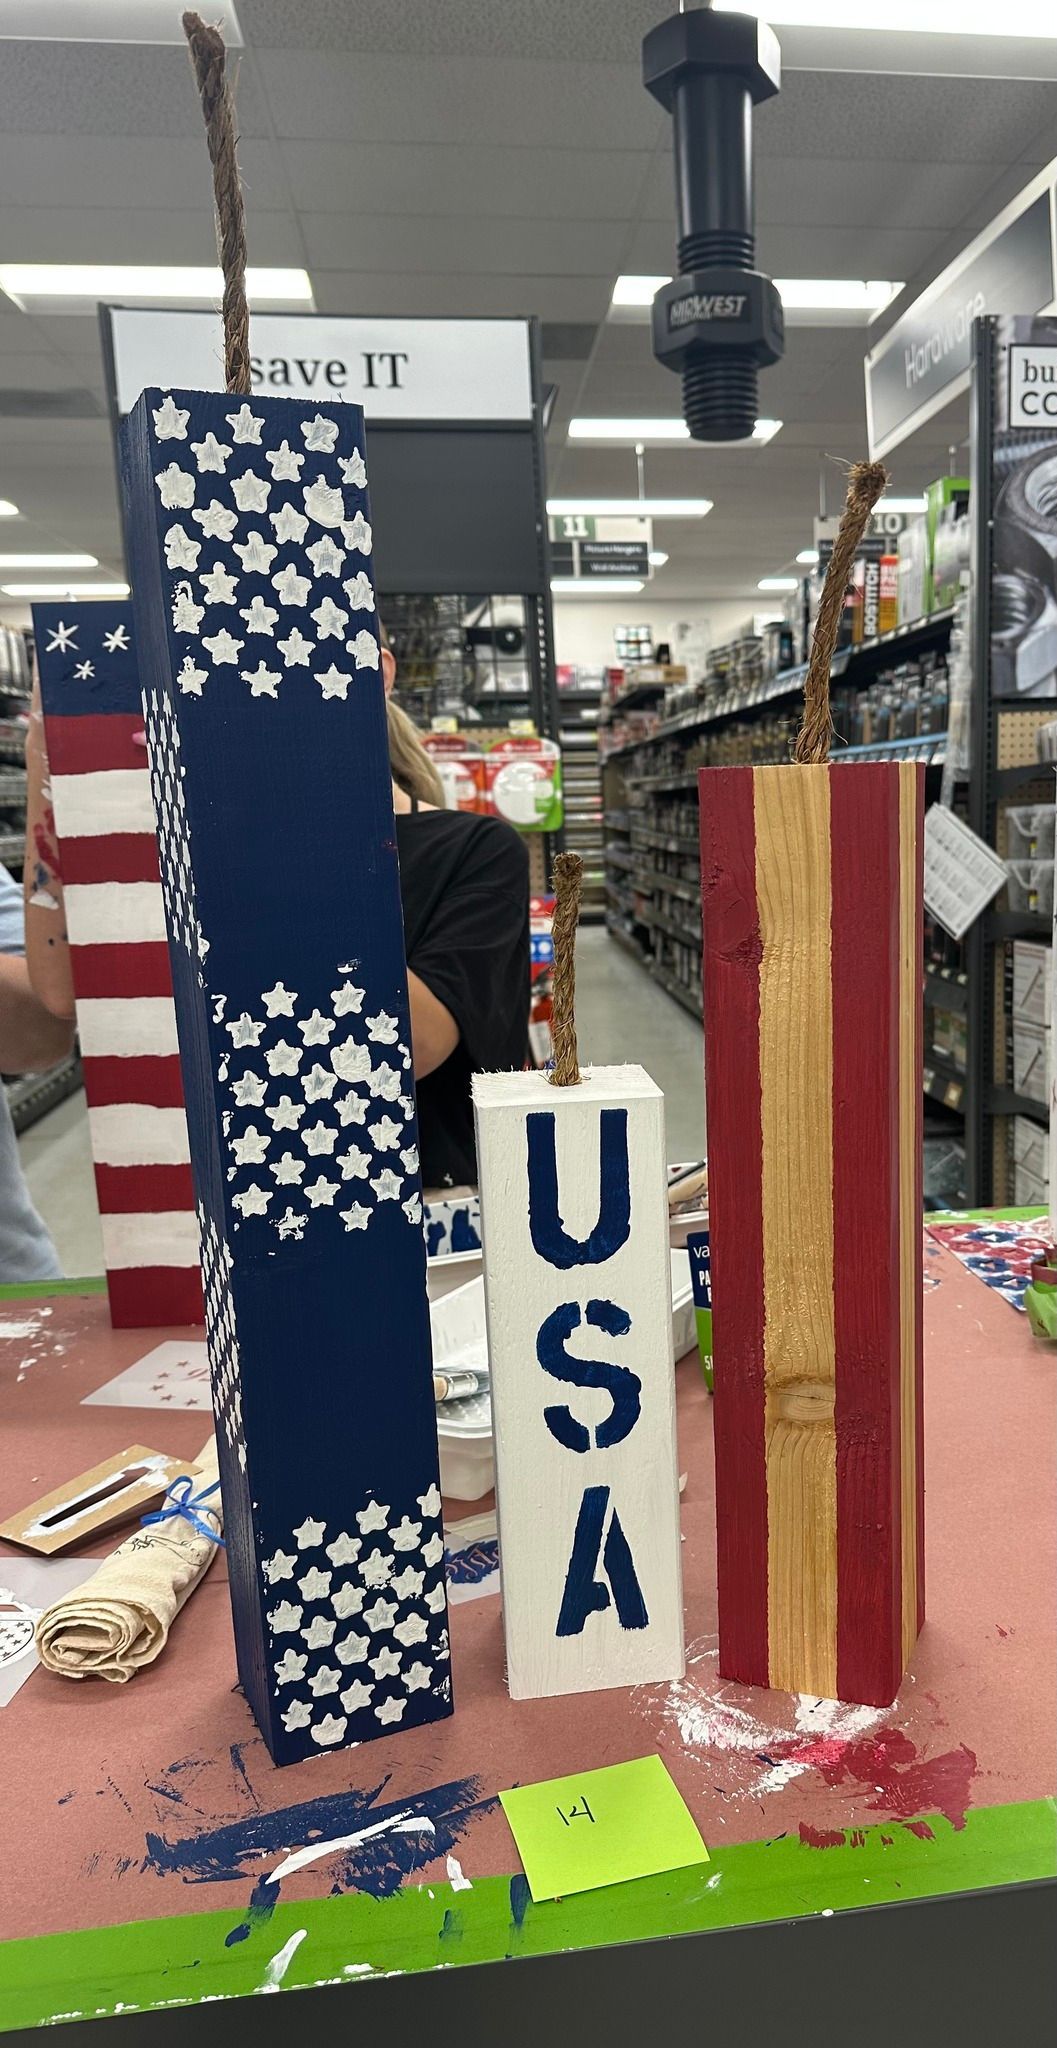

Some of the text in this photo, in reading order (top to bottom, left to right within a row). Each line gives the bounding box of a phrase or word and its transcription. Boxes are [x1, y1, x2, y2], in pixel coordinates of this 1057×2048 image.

[670, 295, 748, 321] MIDWEST
[904, 291, 986, 388] Hardware
[250, 352, 409, 389] save IT
[563, 516, 589, 537] 11
[874, 513, 902, 534] 10
[864, 563, 879, 636] BOSTITCH
[556, 1796, 596, 1826] 14
